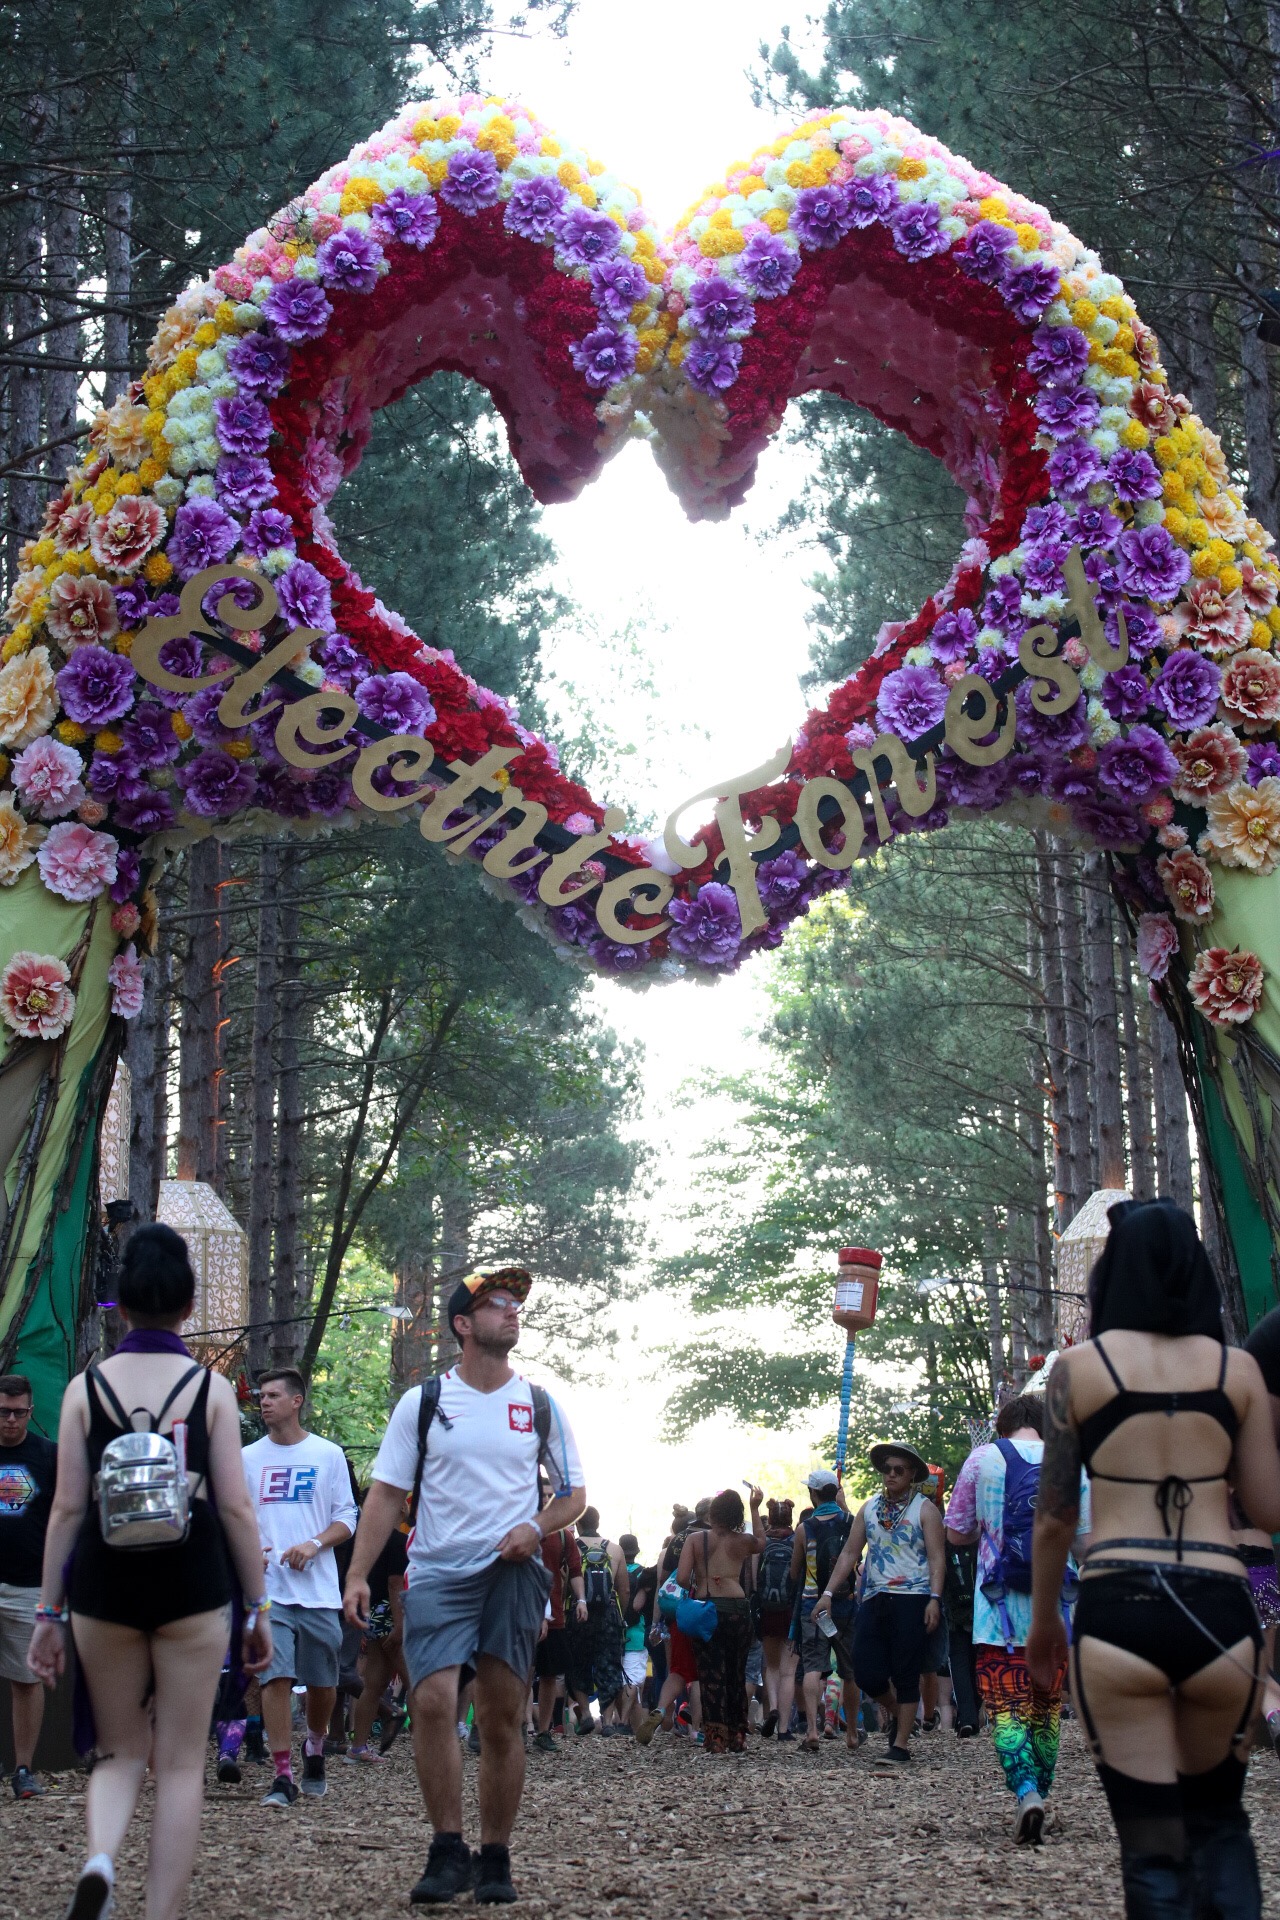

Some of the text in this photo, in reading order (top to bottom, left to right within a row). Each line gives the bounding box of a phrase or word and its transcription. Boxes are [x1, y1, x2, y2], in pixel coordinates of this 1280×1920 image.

[130, 545, 1129, 944] Electric Forest
[262, 1467, 315, 1502] EF
